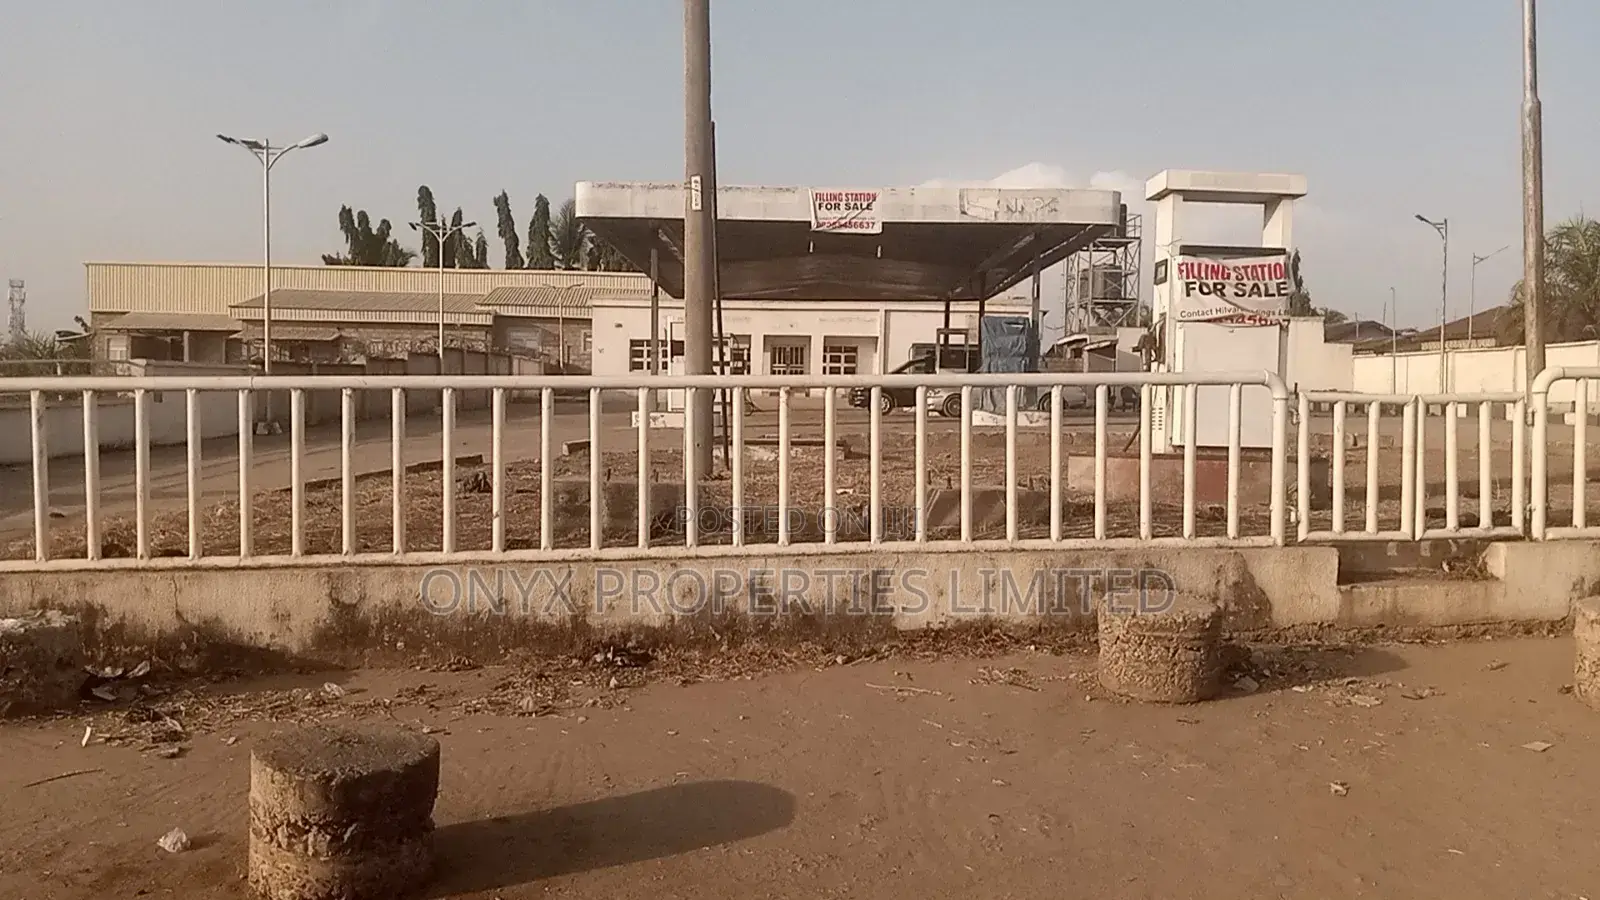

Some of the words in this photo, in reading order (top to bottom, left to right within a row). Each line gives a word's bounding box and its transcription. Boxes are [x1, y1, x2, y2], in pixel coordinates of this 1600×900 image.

[844, 193, 877, 202] STATION
[818, 203, 841, 211] FOR
[844, 202, 873, 211] SALE
[1178, 262, 1231, 280] FILLING
[1185, 282, 1226, 298] FOR
[1234, 282, 1289, 297] SALE
[1180, 308, 1213, 318] Contact
